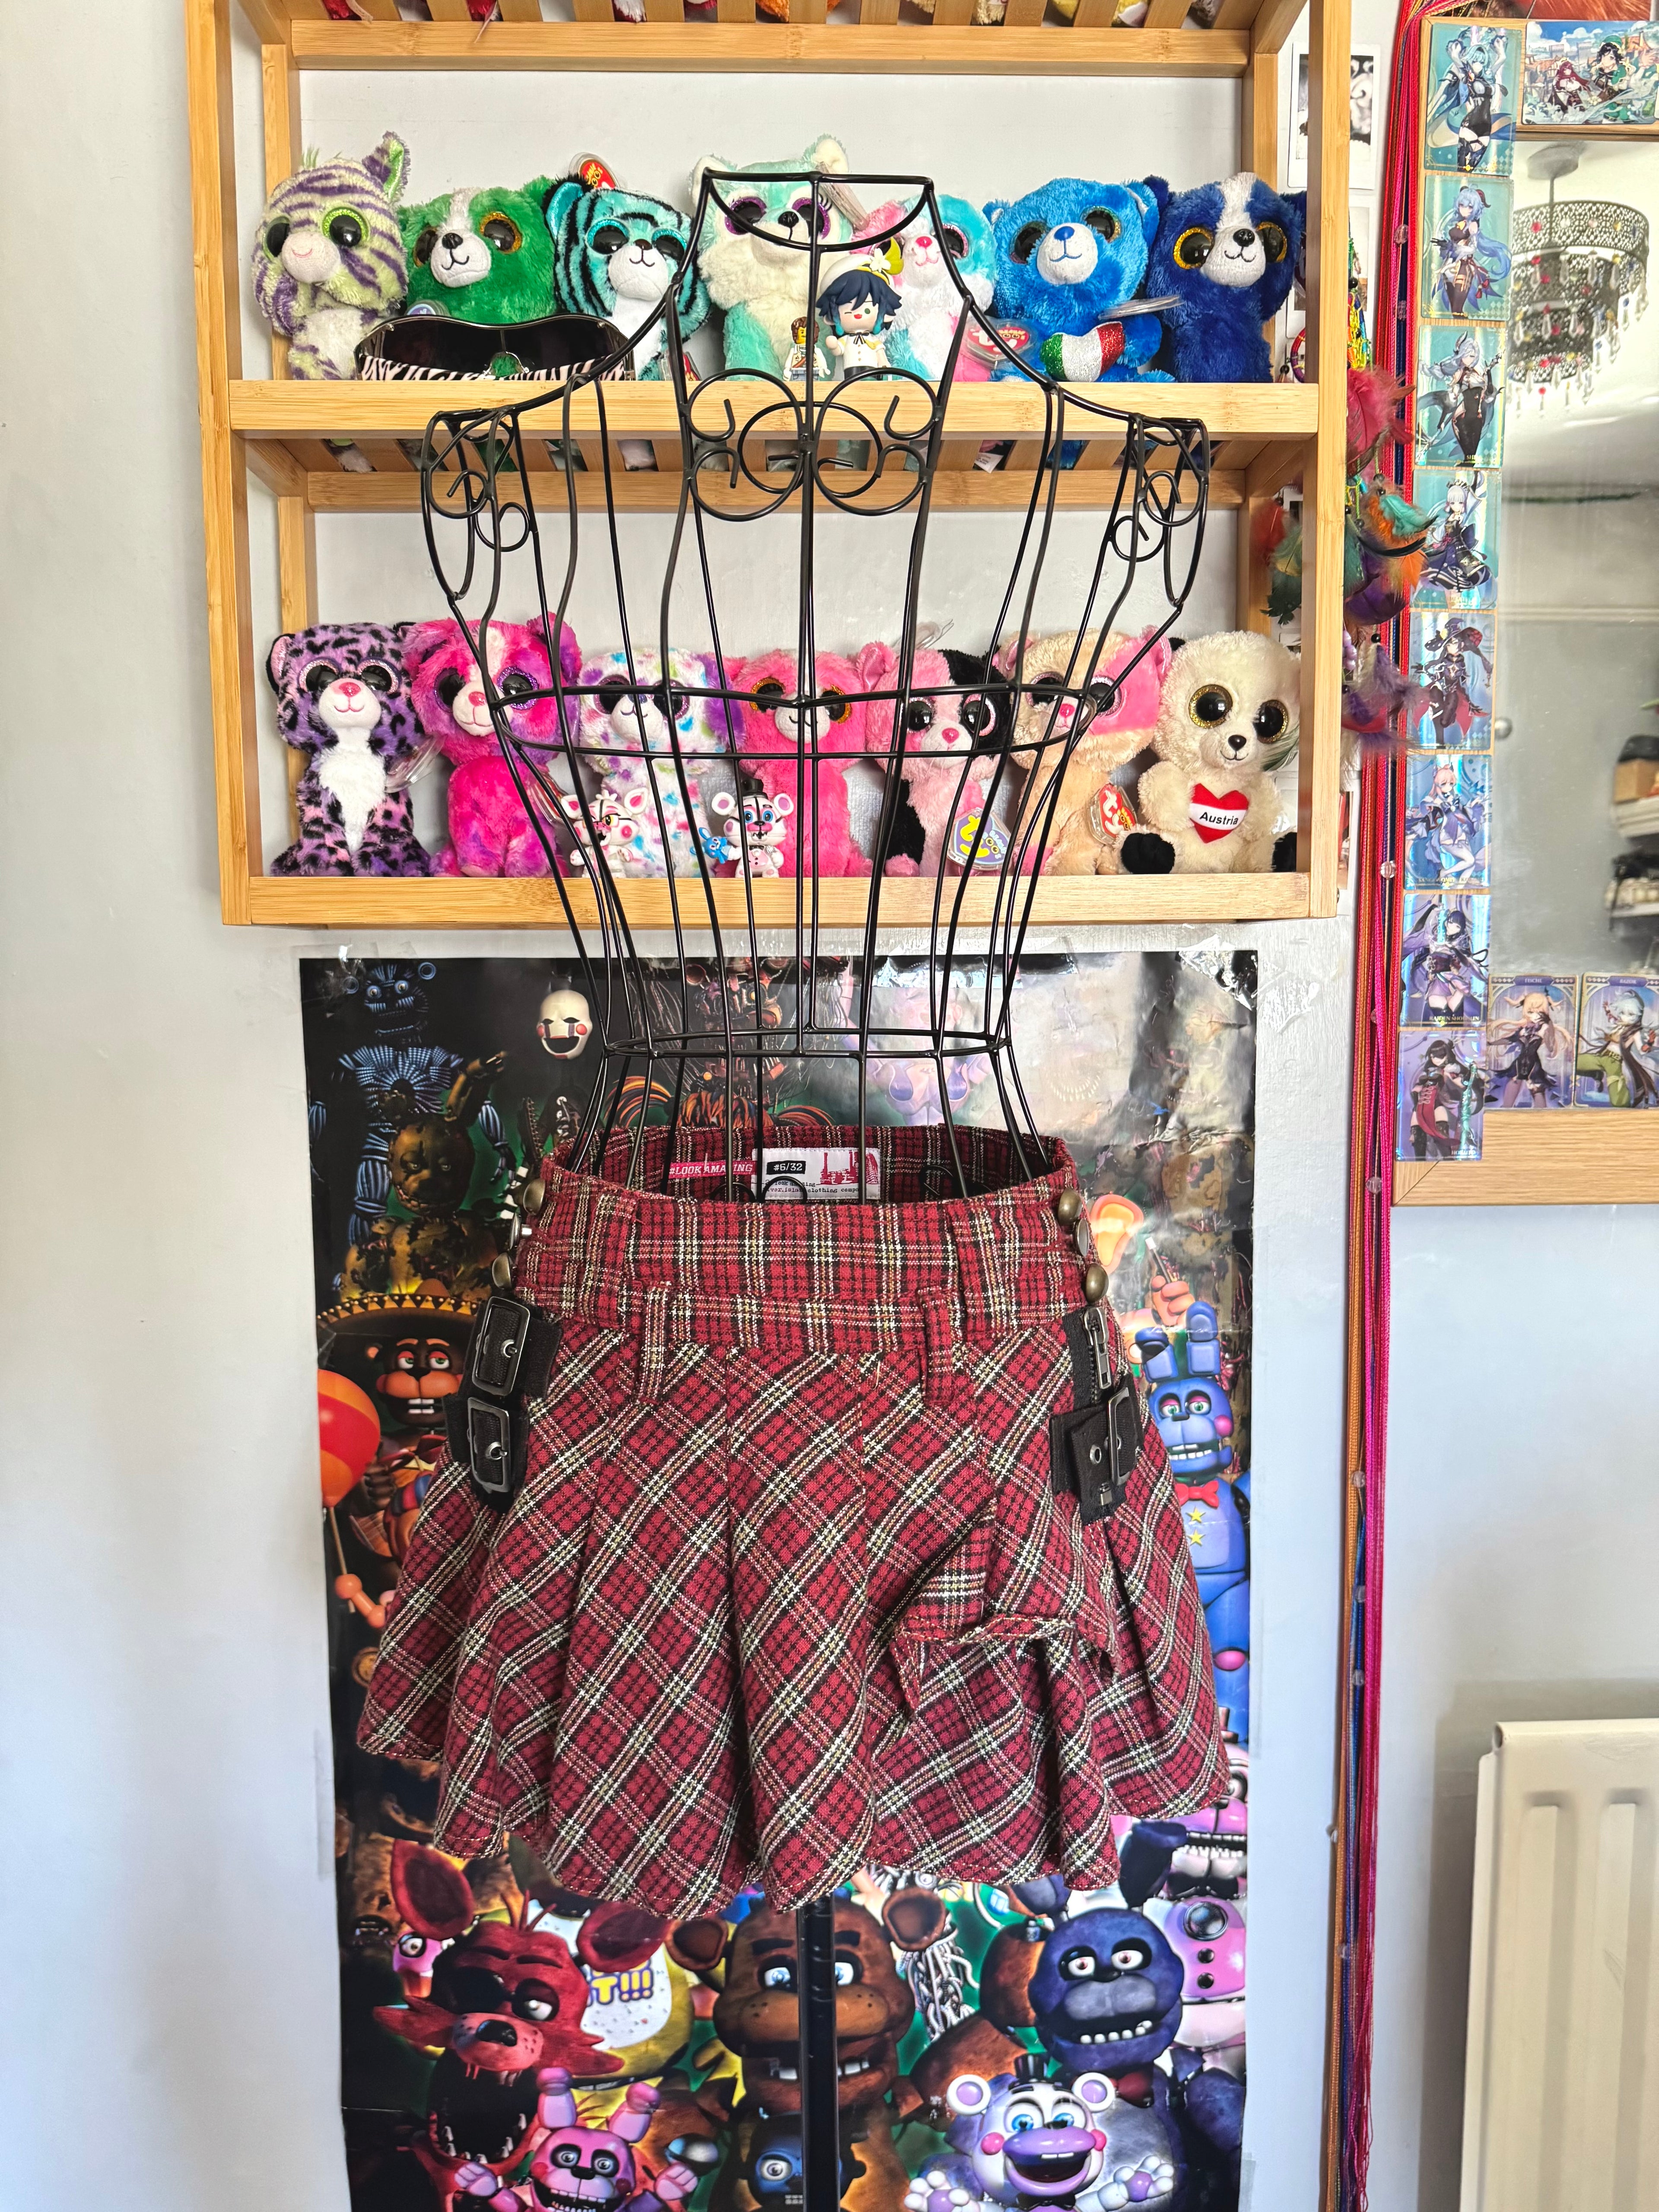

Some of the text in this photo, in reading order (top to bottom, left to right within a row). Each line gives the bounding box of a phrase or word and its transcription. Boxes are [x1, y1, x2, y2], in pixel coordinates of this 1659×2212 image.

[1199, 812, 1239, 825] Austria
[704, 1164, 753, 1173] AMAING
[773, 1162, 803, 1171] #6/32
